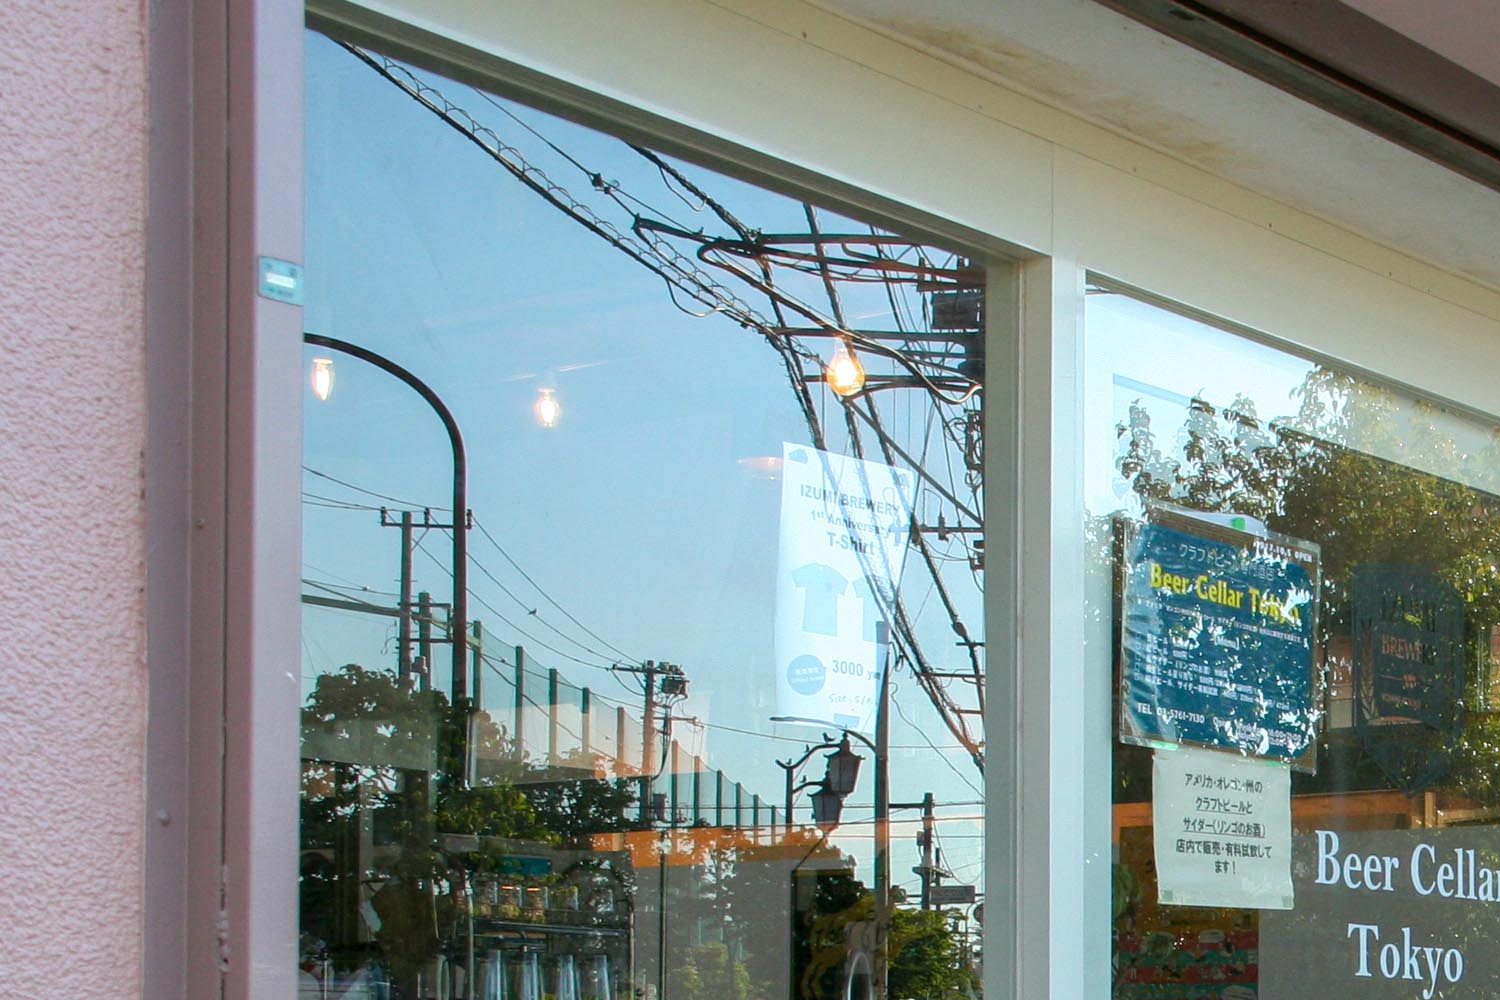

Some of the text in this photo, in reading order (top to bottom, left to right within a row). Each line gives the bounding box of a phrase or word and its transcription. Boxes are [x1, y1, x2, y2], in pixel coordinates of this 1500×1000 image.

[801, 484, 899, 516] IZUMI BREWERY
[826, 531, 875, 555] T-Shirt
[1151, 562, 1190, 594] Beer
[1196, 575, 1244, 609] Cellar
[1380, 632, 1434, 666] BREWE
[832, 660, 864, 677] 3000
[1136, 702, 1152, 715] TEL
[1314, 829, 1400, 892] Beer
[1347, 923, 1465, 1000] Tokyo
